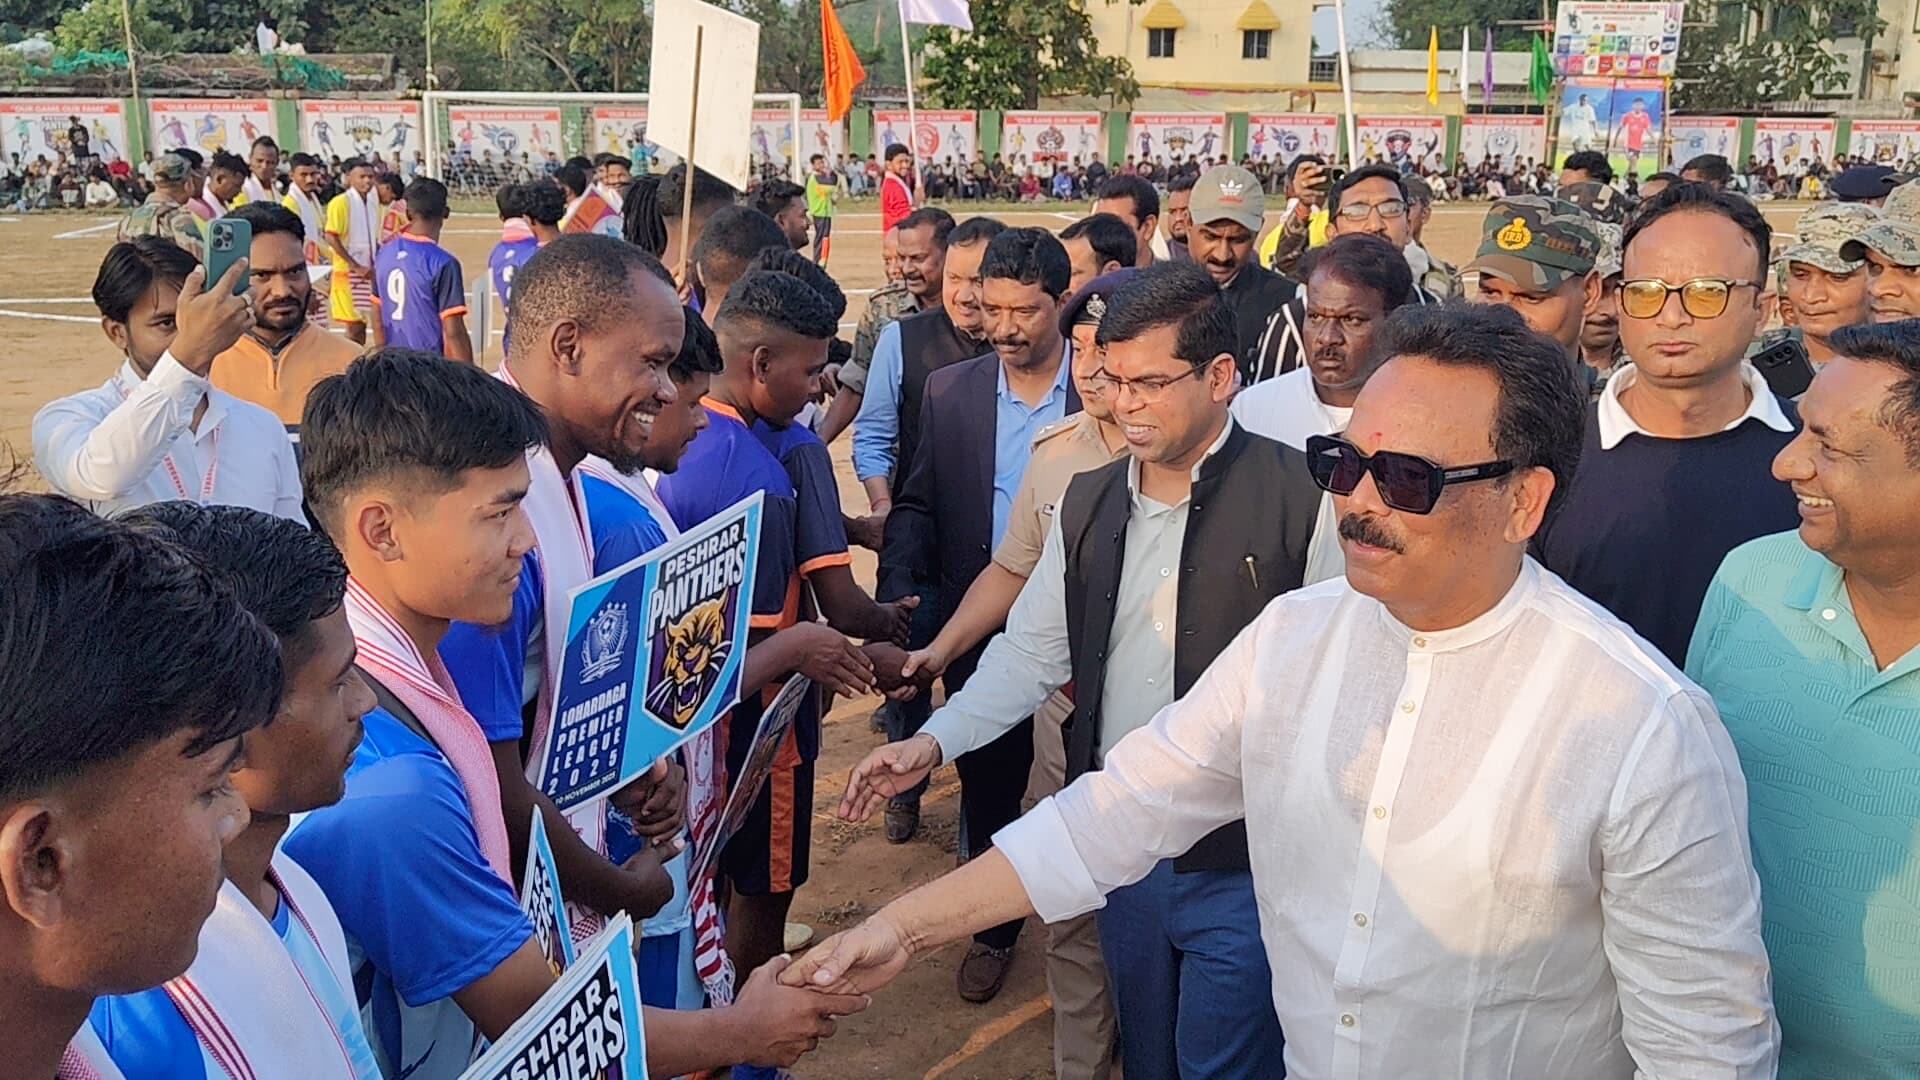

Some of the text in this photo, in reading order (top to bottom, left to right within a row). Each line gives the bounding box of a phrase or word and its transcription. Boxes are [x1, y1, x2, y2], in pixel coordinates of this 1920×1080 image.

[387, 268, 406, 320] 9
[664, 523, 740, 582] PESHRAR
[648, 541, 746, 638] PANTHERS
[556, 705, 624, 752] PREMIER
[560, 682, 627, 730] LOHARDAGA
[547, 749, 618, 796] 2025
[552, 727, 621, 774] LEAGUE
[500, 979, 602, 1080] SHRAR
